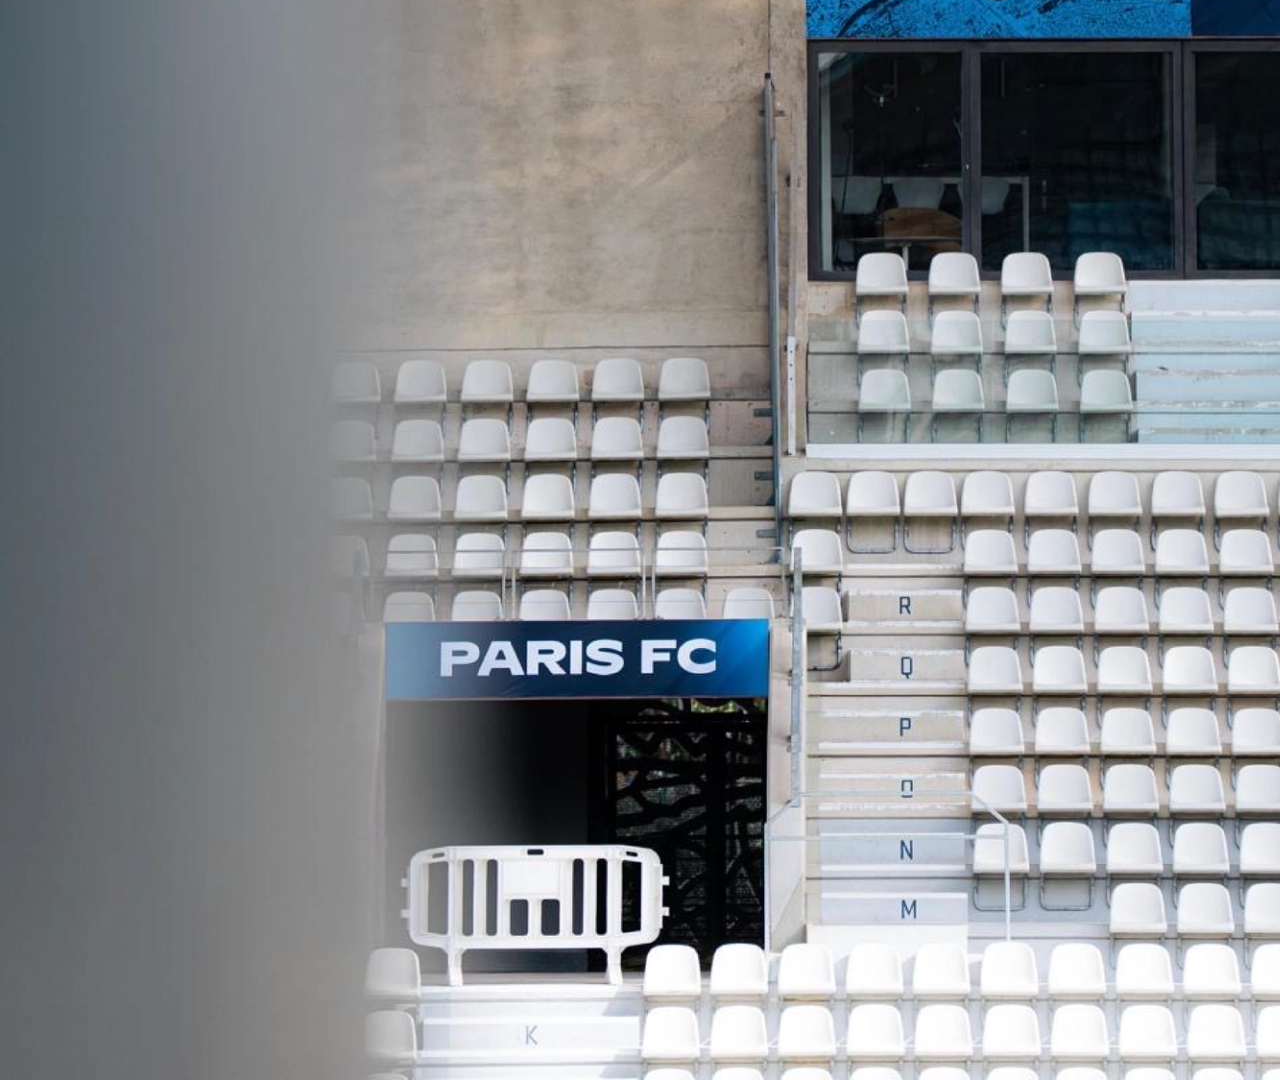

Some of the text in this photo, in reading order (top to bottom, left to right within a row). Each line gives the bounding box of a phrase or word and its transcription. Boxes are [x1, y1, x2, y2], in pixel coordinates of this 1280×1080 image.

[899, 596, 911, 615] R
[440, 638, 717, 677] PARIS FC
[901, 656, 913, 680] Q
[900, 717, 912, 737] P
[900, 839, 914, 860] N
[901, 899, 917, 919] M
[525, 1025, 539, 1046] K
